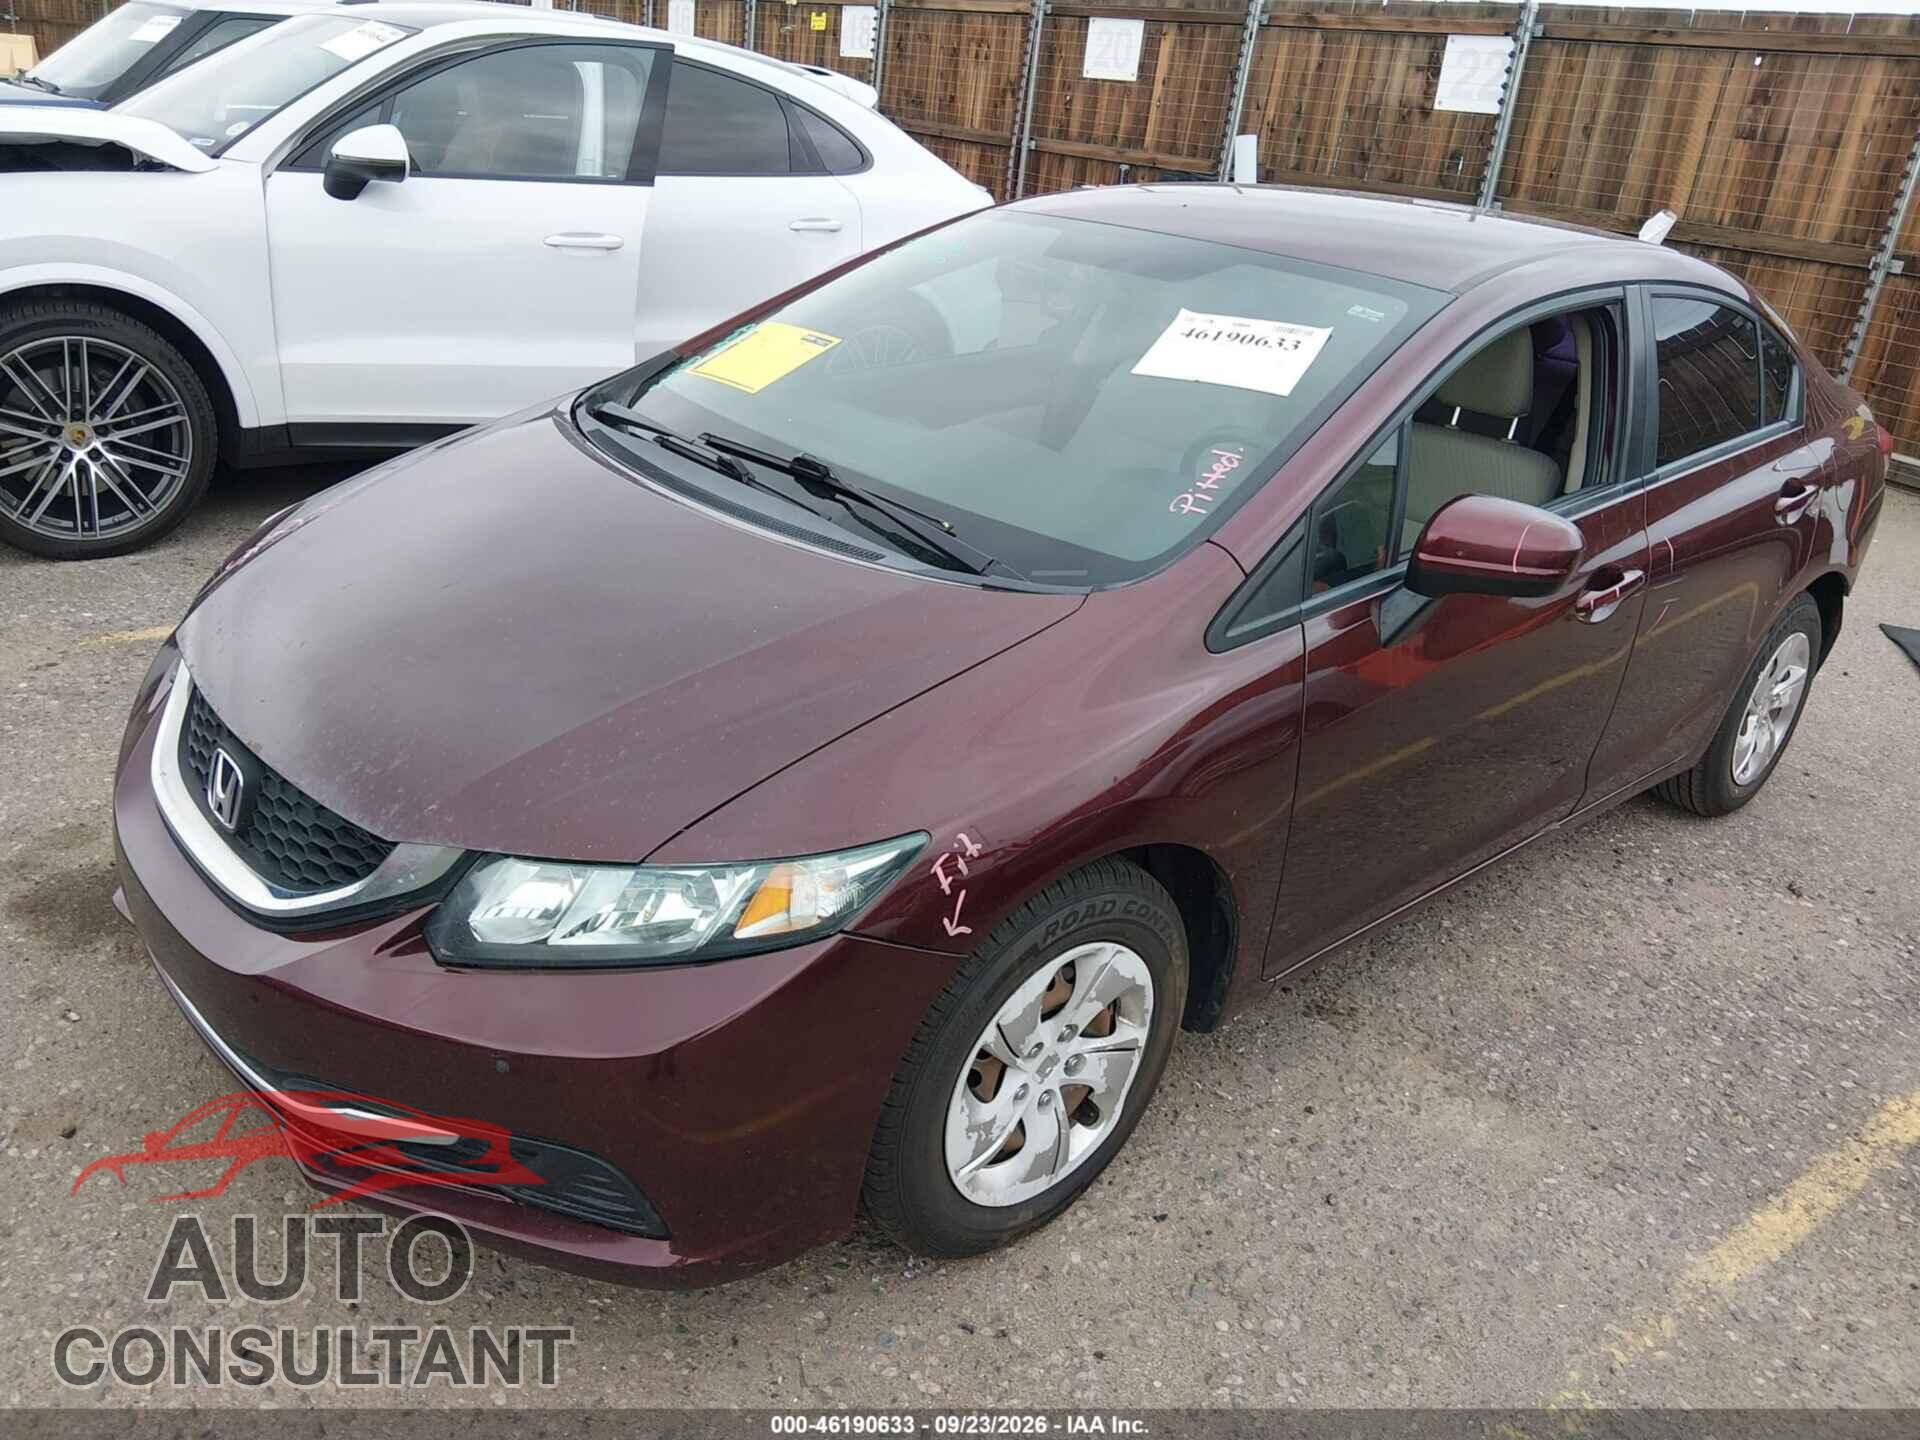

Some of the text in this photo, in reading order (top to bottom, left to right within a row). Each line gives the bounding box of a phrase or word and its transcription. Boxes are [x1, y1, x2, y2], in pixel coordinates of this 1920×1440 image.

[849, 14, 871, 50] 18
[1092, 27, 1133, 70] 20
[1449, 47, 1505, 101] 22
[1180, 327, 1302, 350] 46190633
[1042, 899, 1117, 944] ROAD
